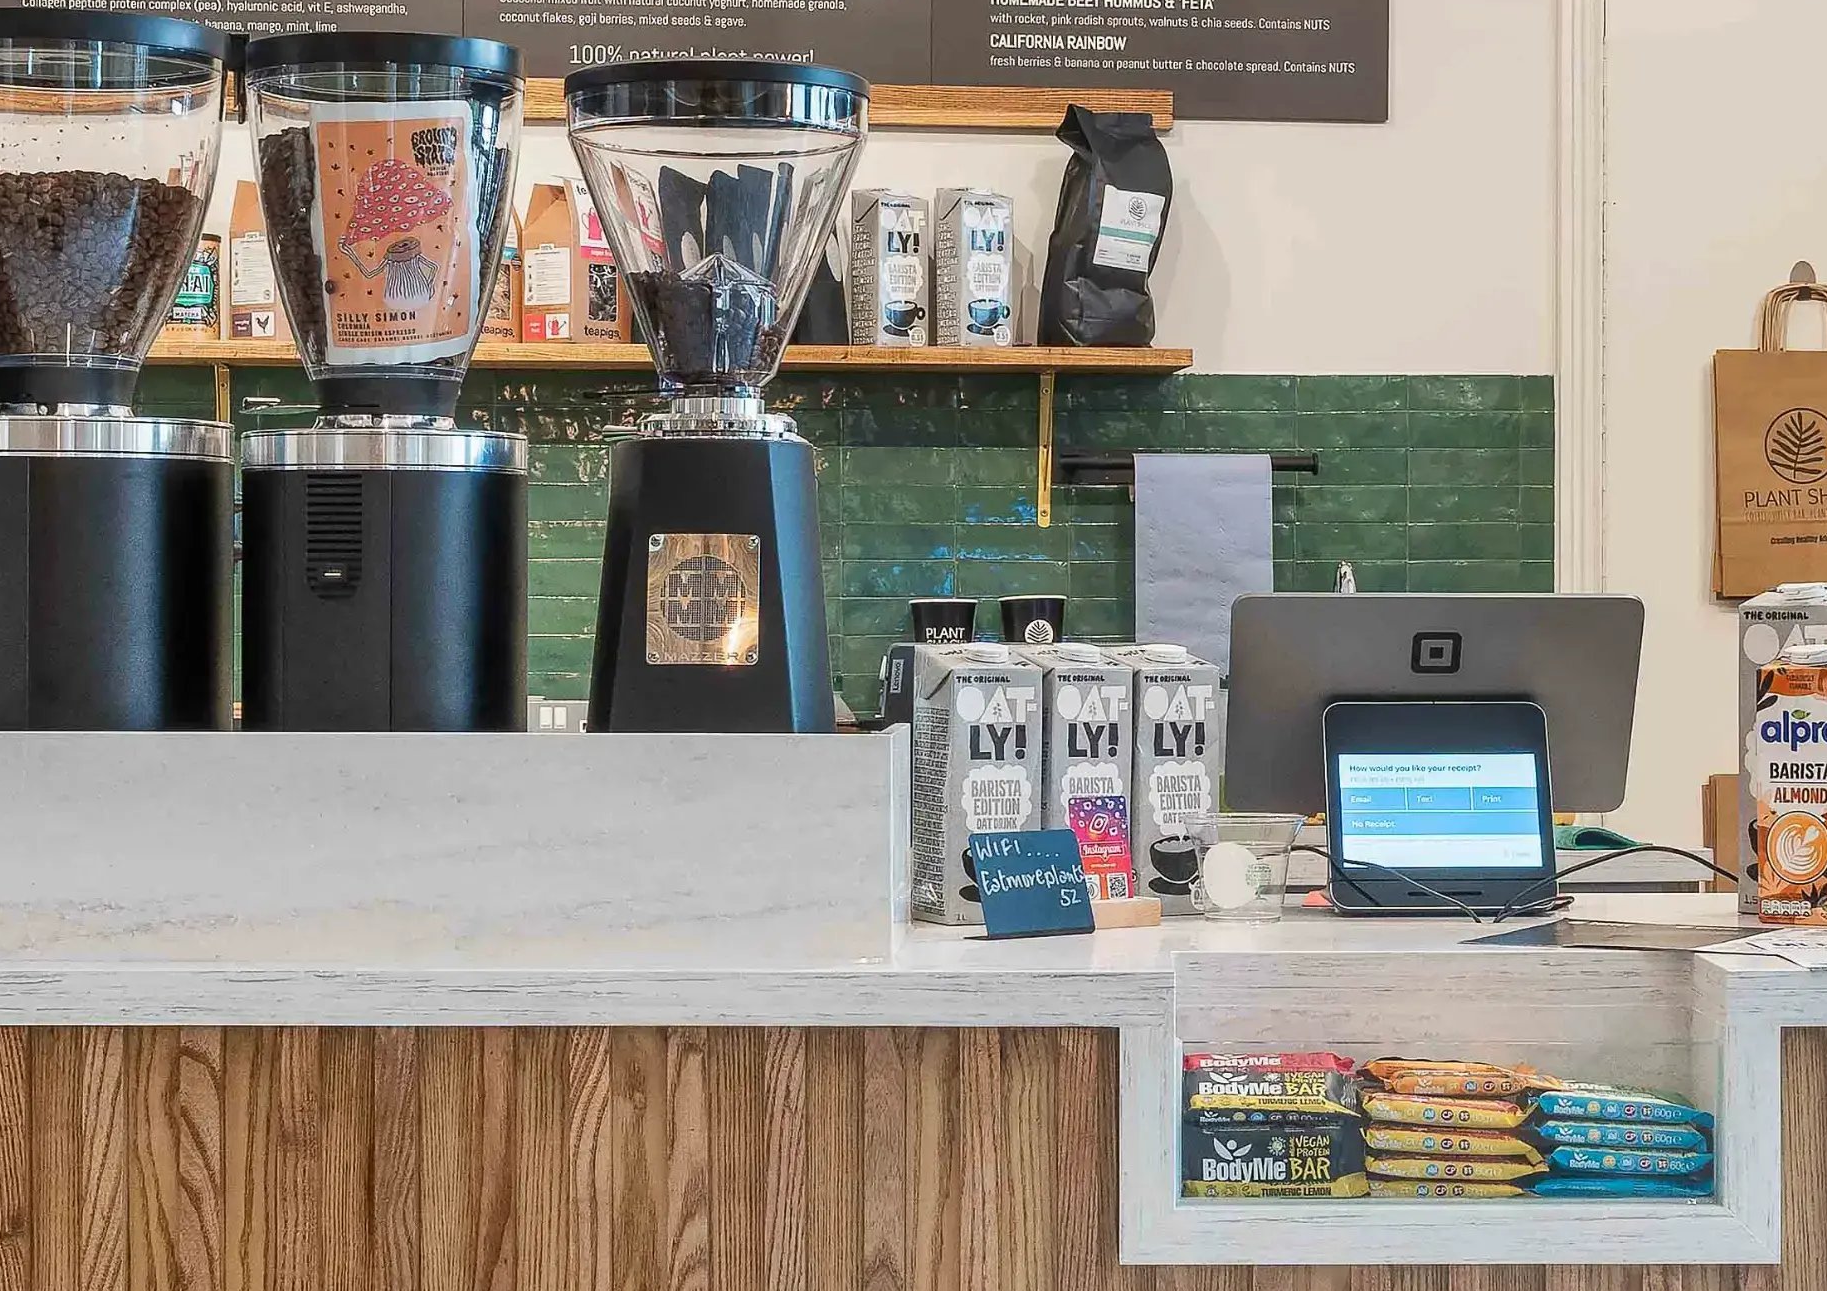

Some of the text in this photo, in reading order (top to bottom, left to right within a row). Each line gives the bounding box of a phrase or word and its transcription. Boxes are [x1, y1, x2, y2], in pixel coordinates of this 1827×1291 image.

[337, 311, 416, 322] SILLY SIMON
[1745, 490, 1802, 508] PLANT
[926, 627, 965, 639] PLANT
[892, 661, 902, 690] Lenovo
[970, 722, 1026, 760] LY!
[1395, 765, 1410, 773] you
[1428, 765, 1445, 773] your
[1448, 765, 1481, 773] receipt?
[972, 780, 1021, 797] BARISTA
[1774, 787, 1827, 804] ALMOND
[1482, 795, 1501, 803] Print
[974, 798, 1020, 816] EDITION
[1082, 844, 1122, 855] Instagram
[1296, 1136, 1330, 1147] VEGAN
[1296, 1148, 1330, 1157] PROTEIN
[1202, 1158, 1287, 1183] BodyMe
[1291, 1158, 1330, 1180] BAR
[1261, 1188, 1331, 1196] TURMERIC LEMON
